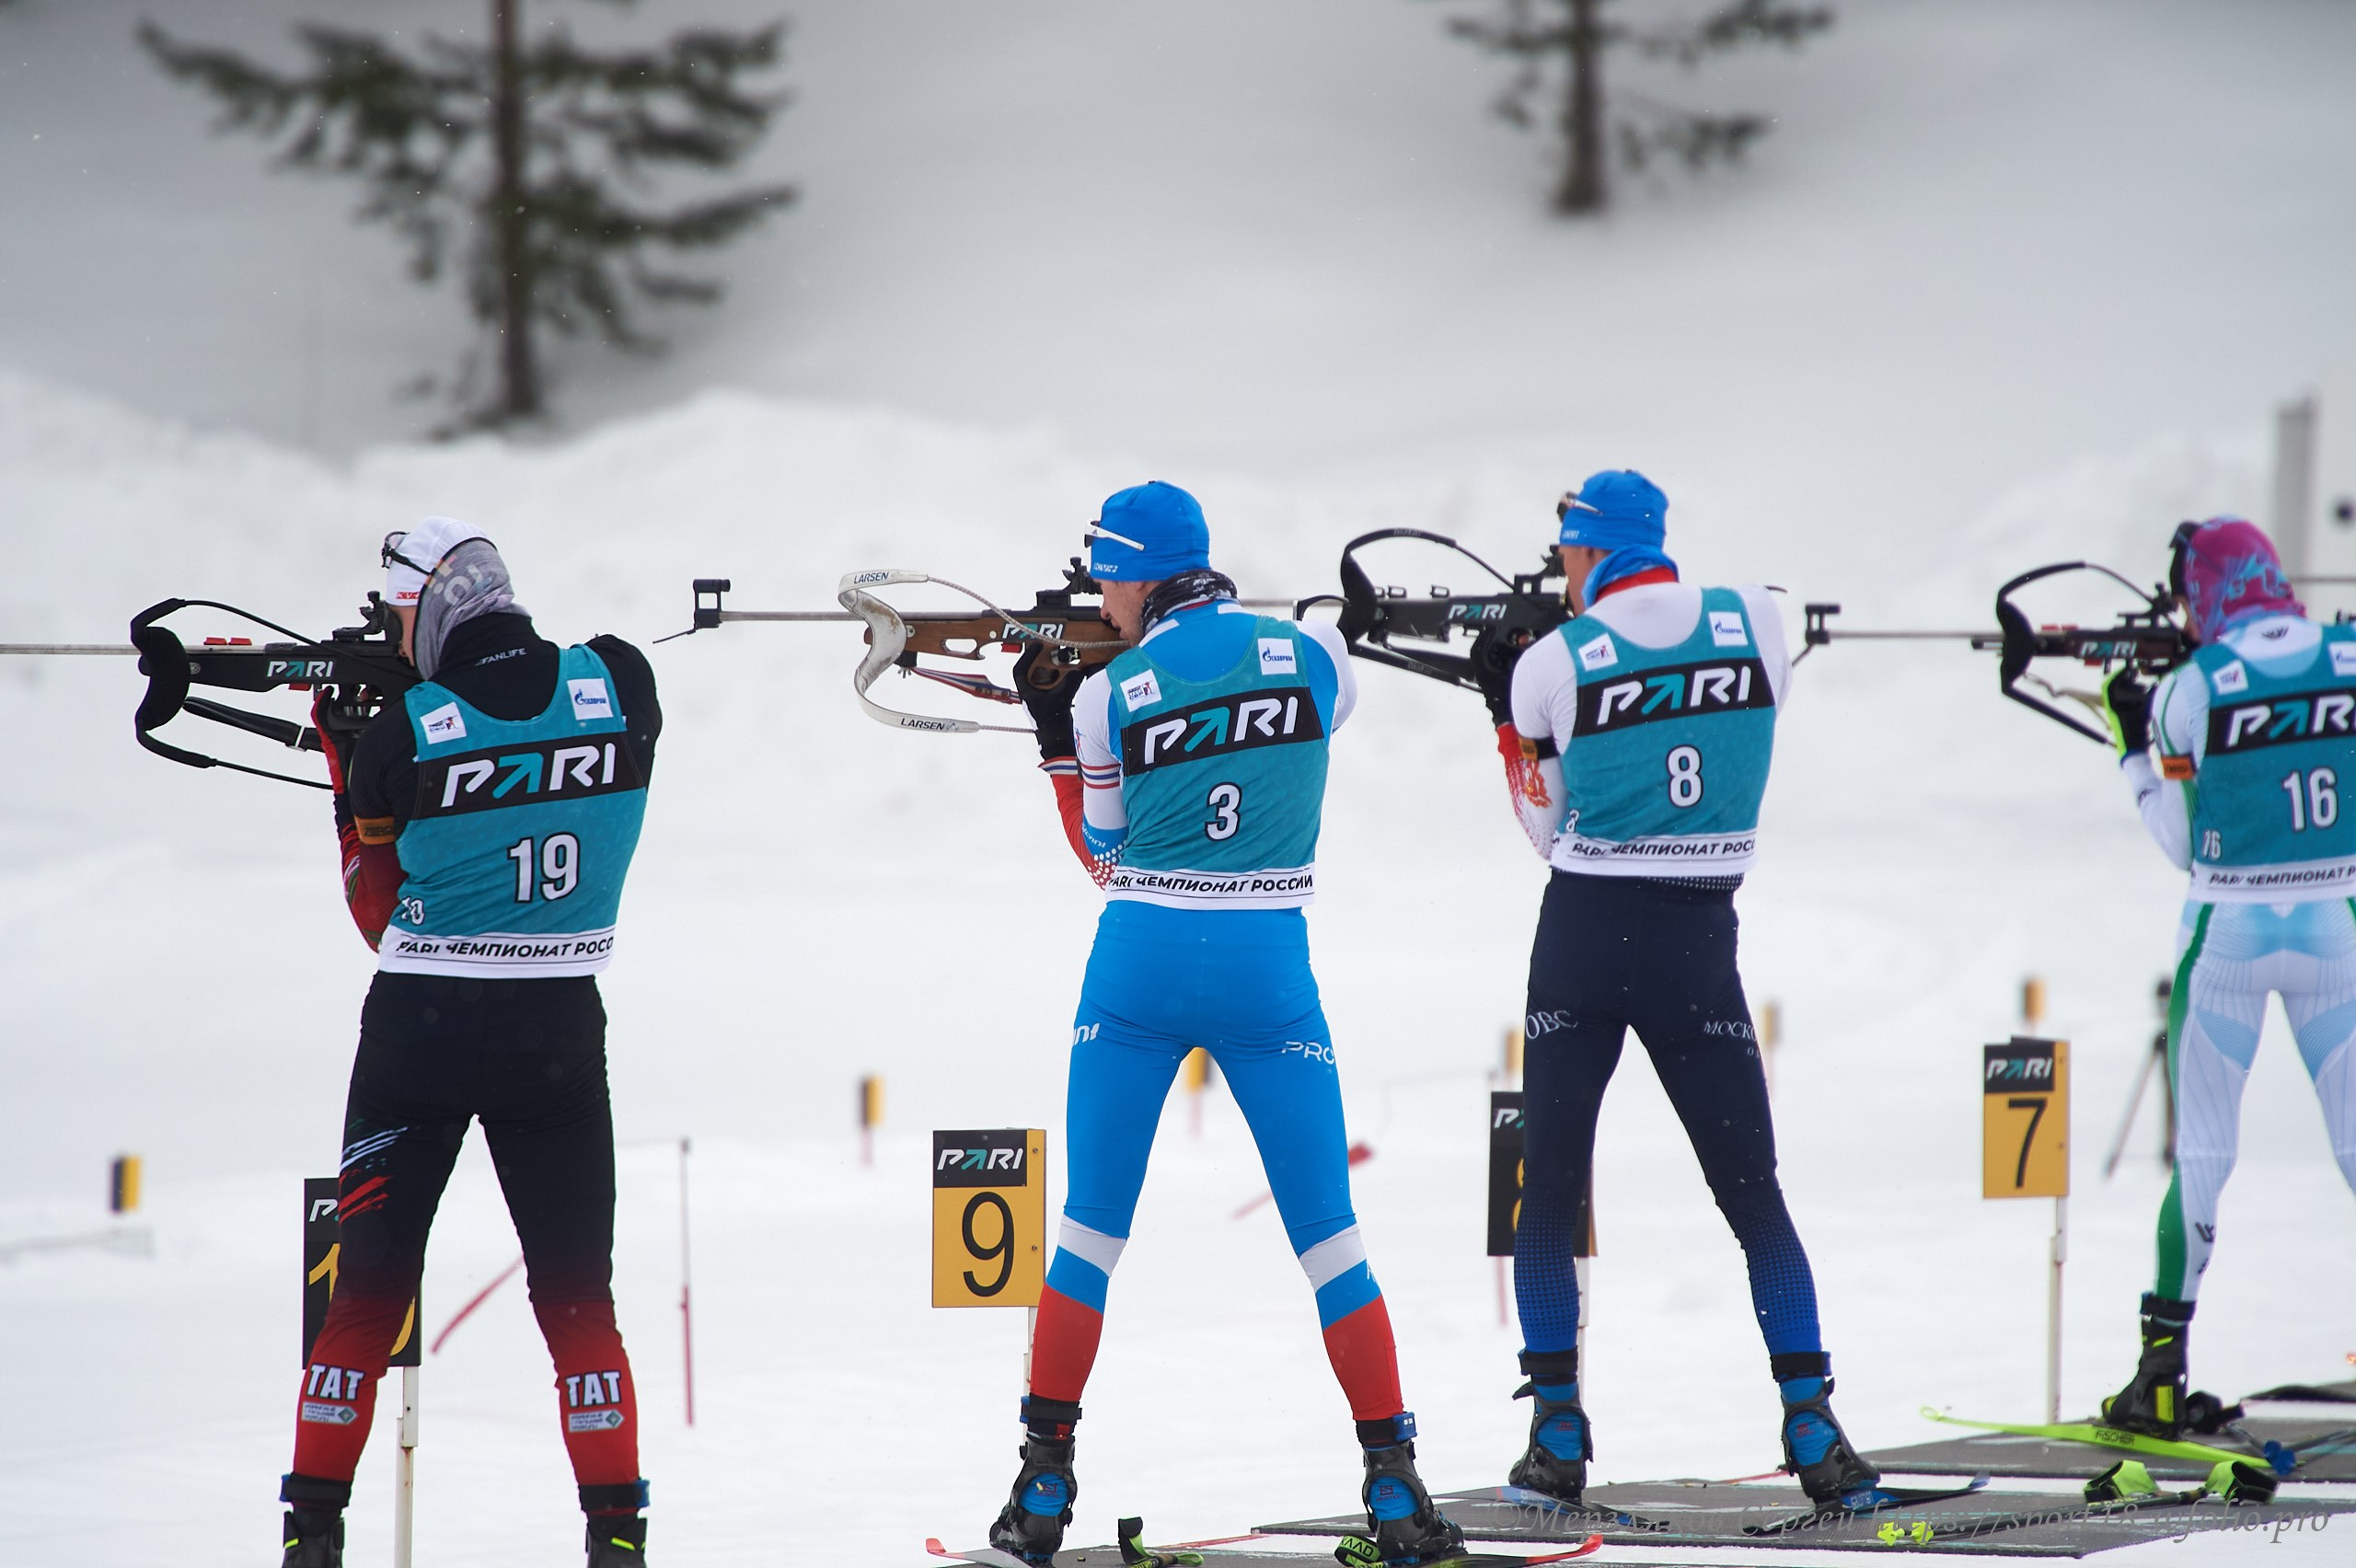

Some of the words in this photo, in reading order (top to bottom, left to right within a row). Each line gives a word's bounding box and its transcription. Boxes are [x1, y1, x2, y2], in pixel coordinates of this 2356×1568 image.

[853, 571, 890, 584] LARSEN
[1449, 604, 1507, 619] PARI
[1002, 623, 1064, 639] PARI
[2081, 641, 2138, 657] PARI
[266, 661, 334, 677] PARI
[1597, 665, 1752, 726] PARI
[901, 718, 945, 731] LARSEN
[1144, 696, 1299, 765] PARI
[2226, 694, 2356, 748] PAR
[440, 742, 617, 808] PARI
[1666, 744, 1704, 809] 8
[2282, 766, 2340, 832] 16
[1204, 780, 1243, 842] 3
[507, 831, 581, 904] 19
[2246, 867, 2346, 885] ЧЕМПИОНАТ
[1136, 876, 1250, 893] ЧЕМПИОНАТ
[1251, 874, 1313, 892] РОССИИ
[445, 942, 572, 957] ЧЕМПИОНАТ
[1986, 1057, 2053, 1080] PARI
[2007, 1098, 2048, 1189] 7
[937, 1148, 1023, 1170] PARI
[962, 1191, 1014, 1297] 9
